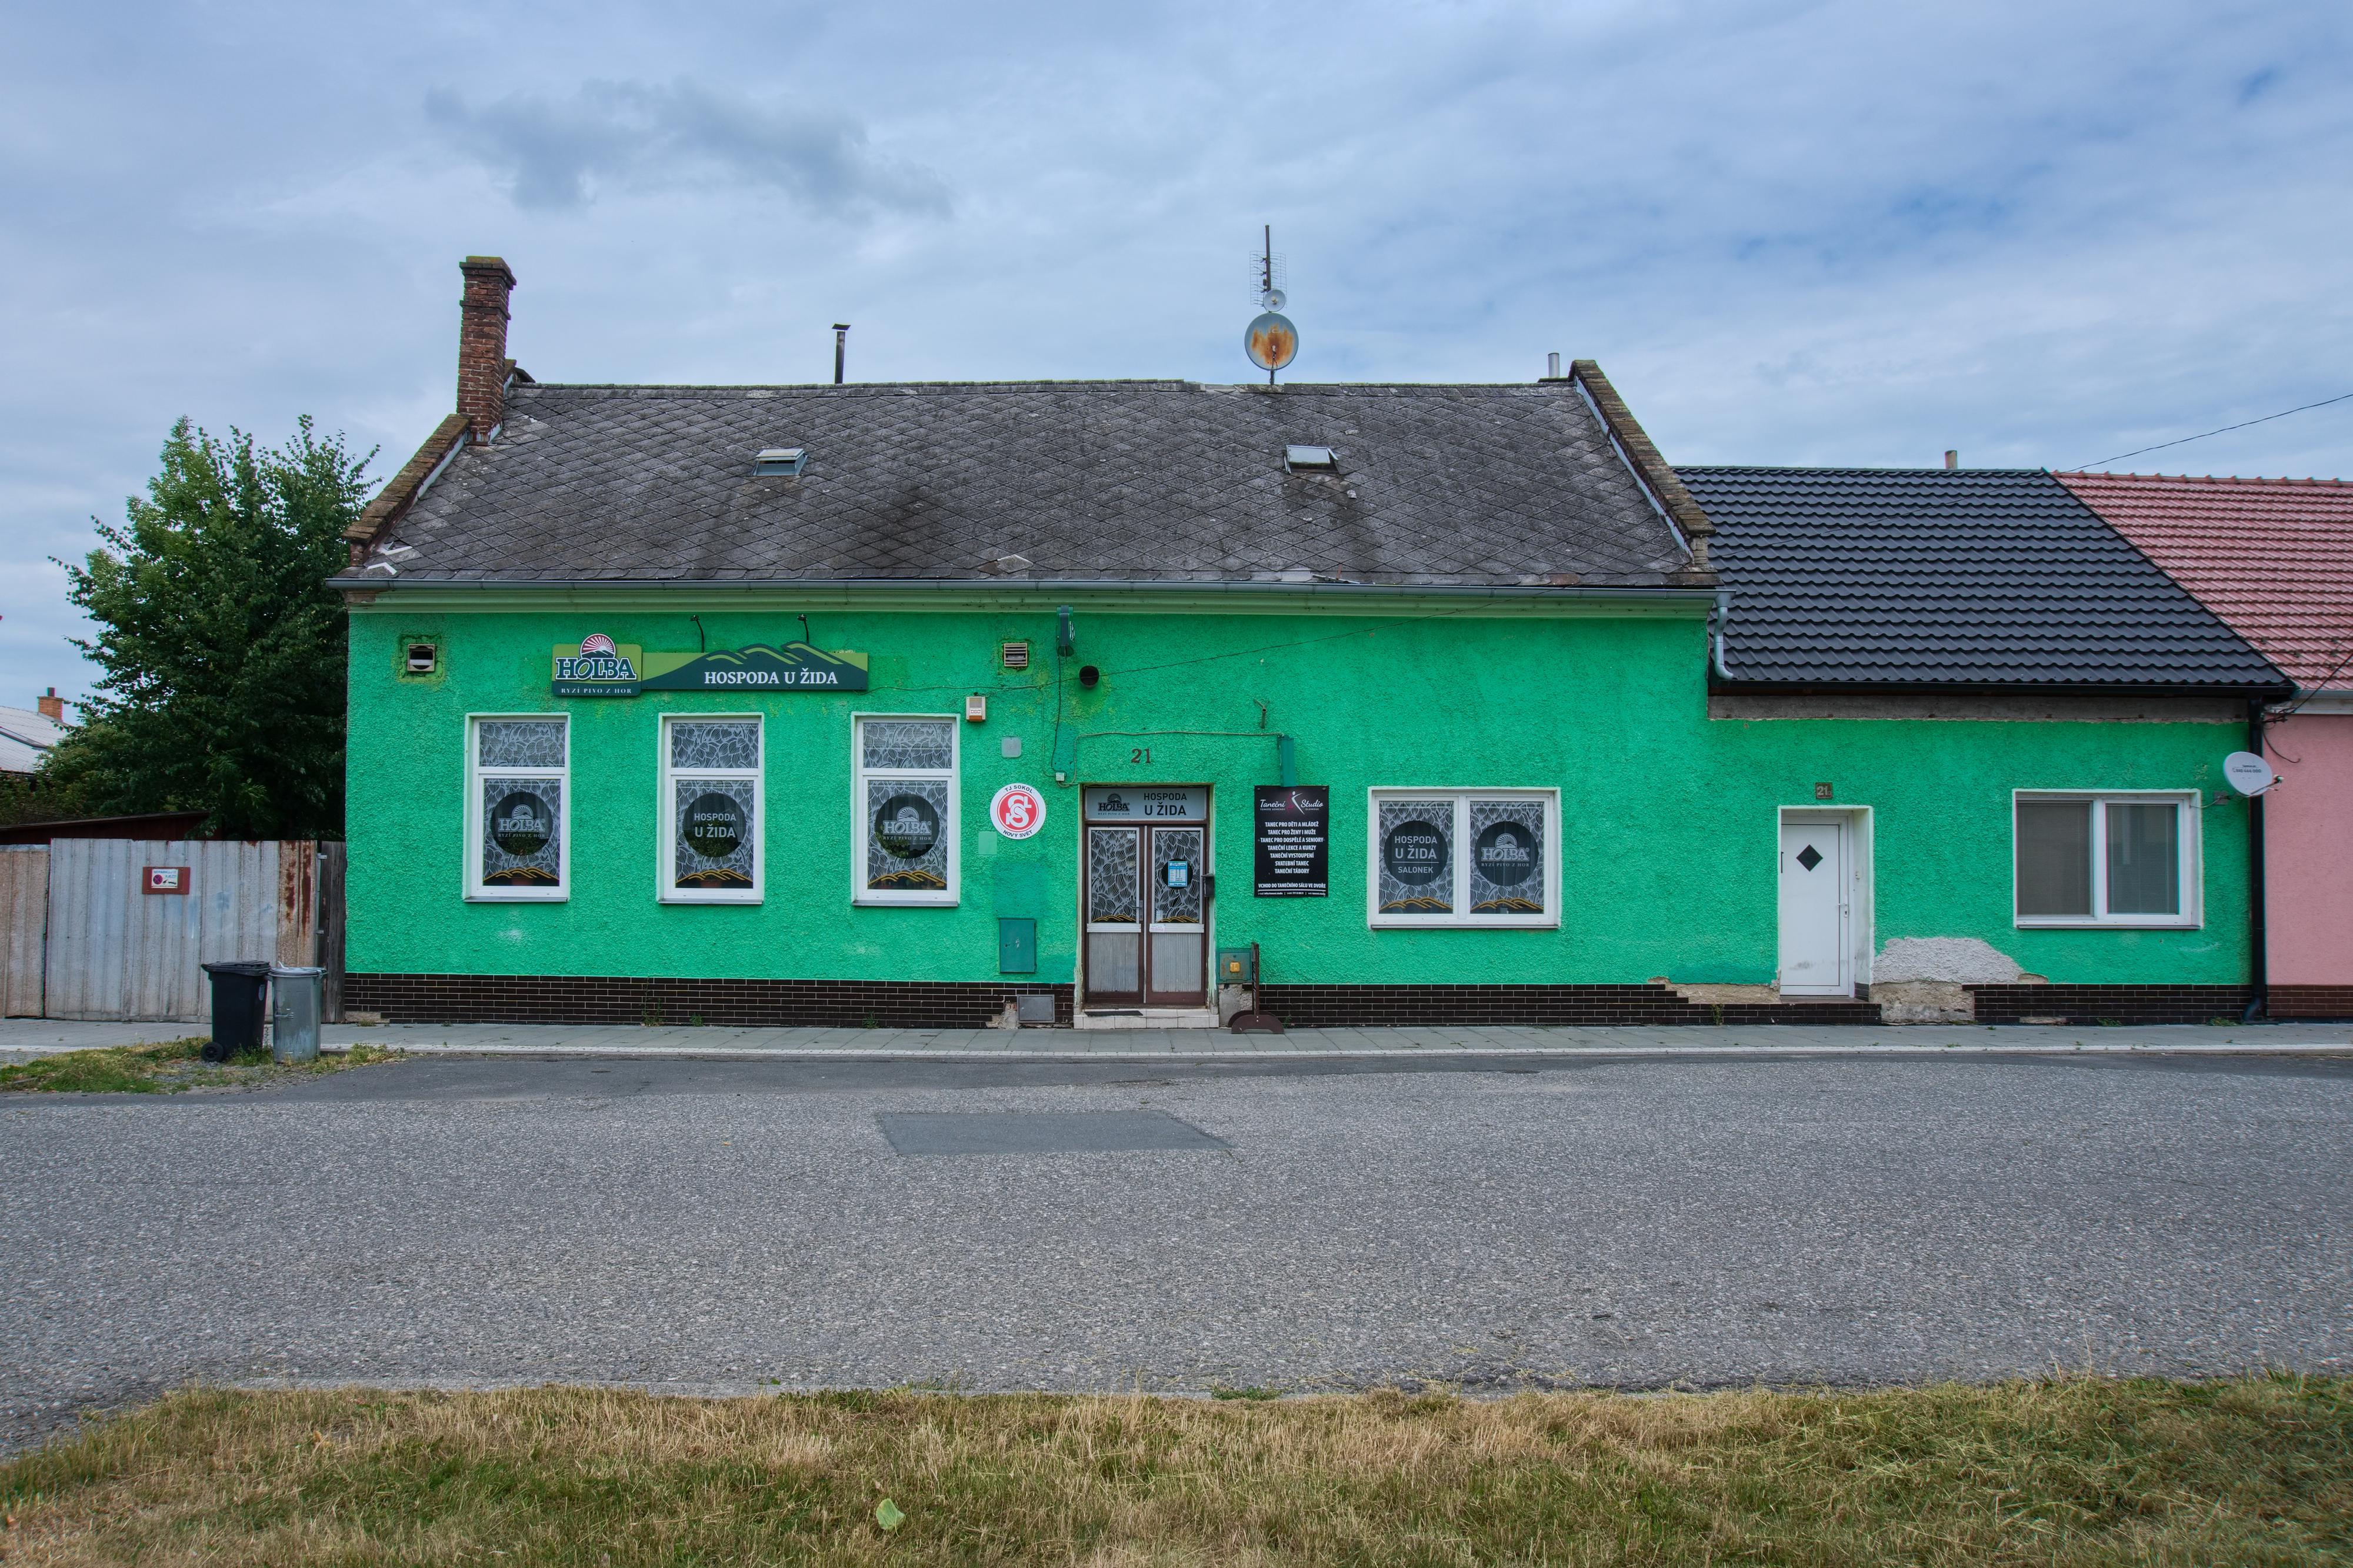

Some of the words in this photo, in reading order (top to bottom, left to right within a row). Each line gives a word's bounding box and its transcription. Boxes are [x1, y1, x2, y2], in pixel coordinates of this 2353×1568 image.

[555, 657, 637, 680] HOLBA
[704, 672, 780, 684] HOSPODA
[784, 672, 795, 684] U
[799, 667, 838, 684] ŽIDA
[1131, 748, 1151, 763] 21
[1014, 785, 1032, 793] SOKOL
[1098, 803, 1129, 812] HOLBA
[1145, 805, 1153, 816] U
[1156, 802, 1187, 816] ŽIDA
[1260, 799, 1286, 808] Taneční
[1301, 799, 1324, 808] Studio
[694, 813, 736, 821] HOSPODA
[498, 818, 545, 832] HOLBA
[695, 826, 703, 838] U
[706, 823, 736, 838] ŽIDA
[883, 820, 932, 835] HOLBA
[1395, 836, 1438, 844] HOSPODA
[1395, 848, 1404, 859] U
[1407, 845, 1437, 859] ŽIDA
[1481, 847, 1529, 861] HOLBA
